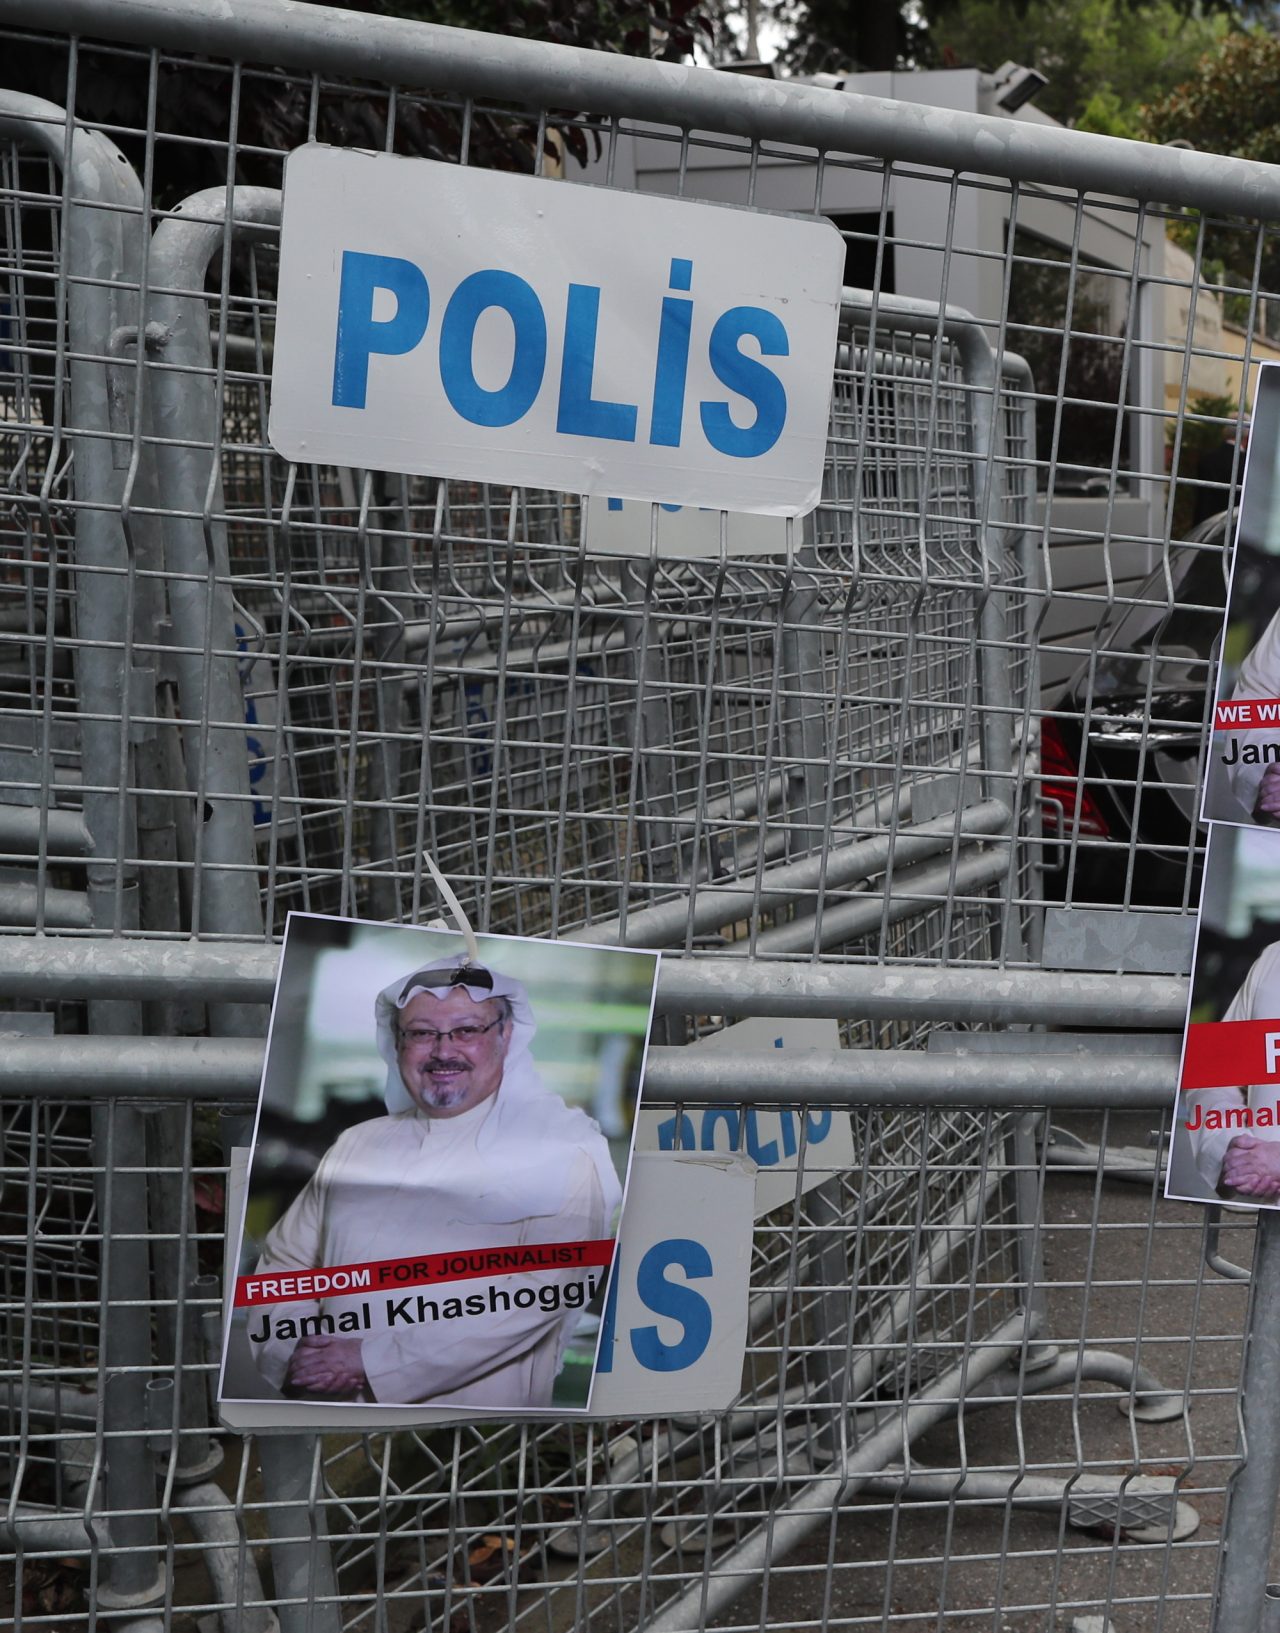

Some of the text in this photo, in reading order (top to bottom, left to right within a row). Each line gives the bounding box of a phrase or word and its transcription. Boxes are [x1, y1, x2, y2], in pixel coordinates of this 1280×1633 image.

[332, 251, 789, 458] POLİS
[1217, 706, 1252, 723] WE
[246, 1246, 587, 1300] FREEDOM FOR JOURNALIST
[250, 1274, 596, 1344] Jamal Khashoggi
